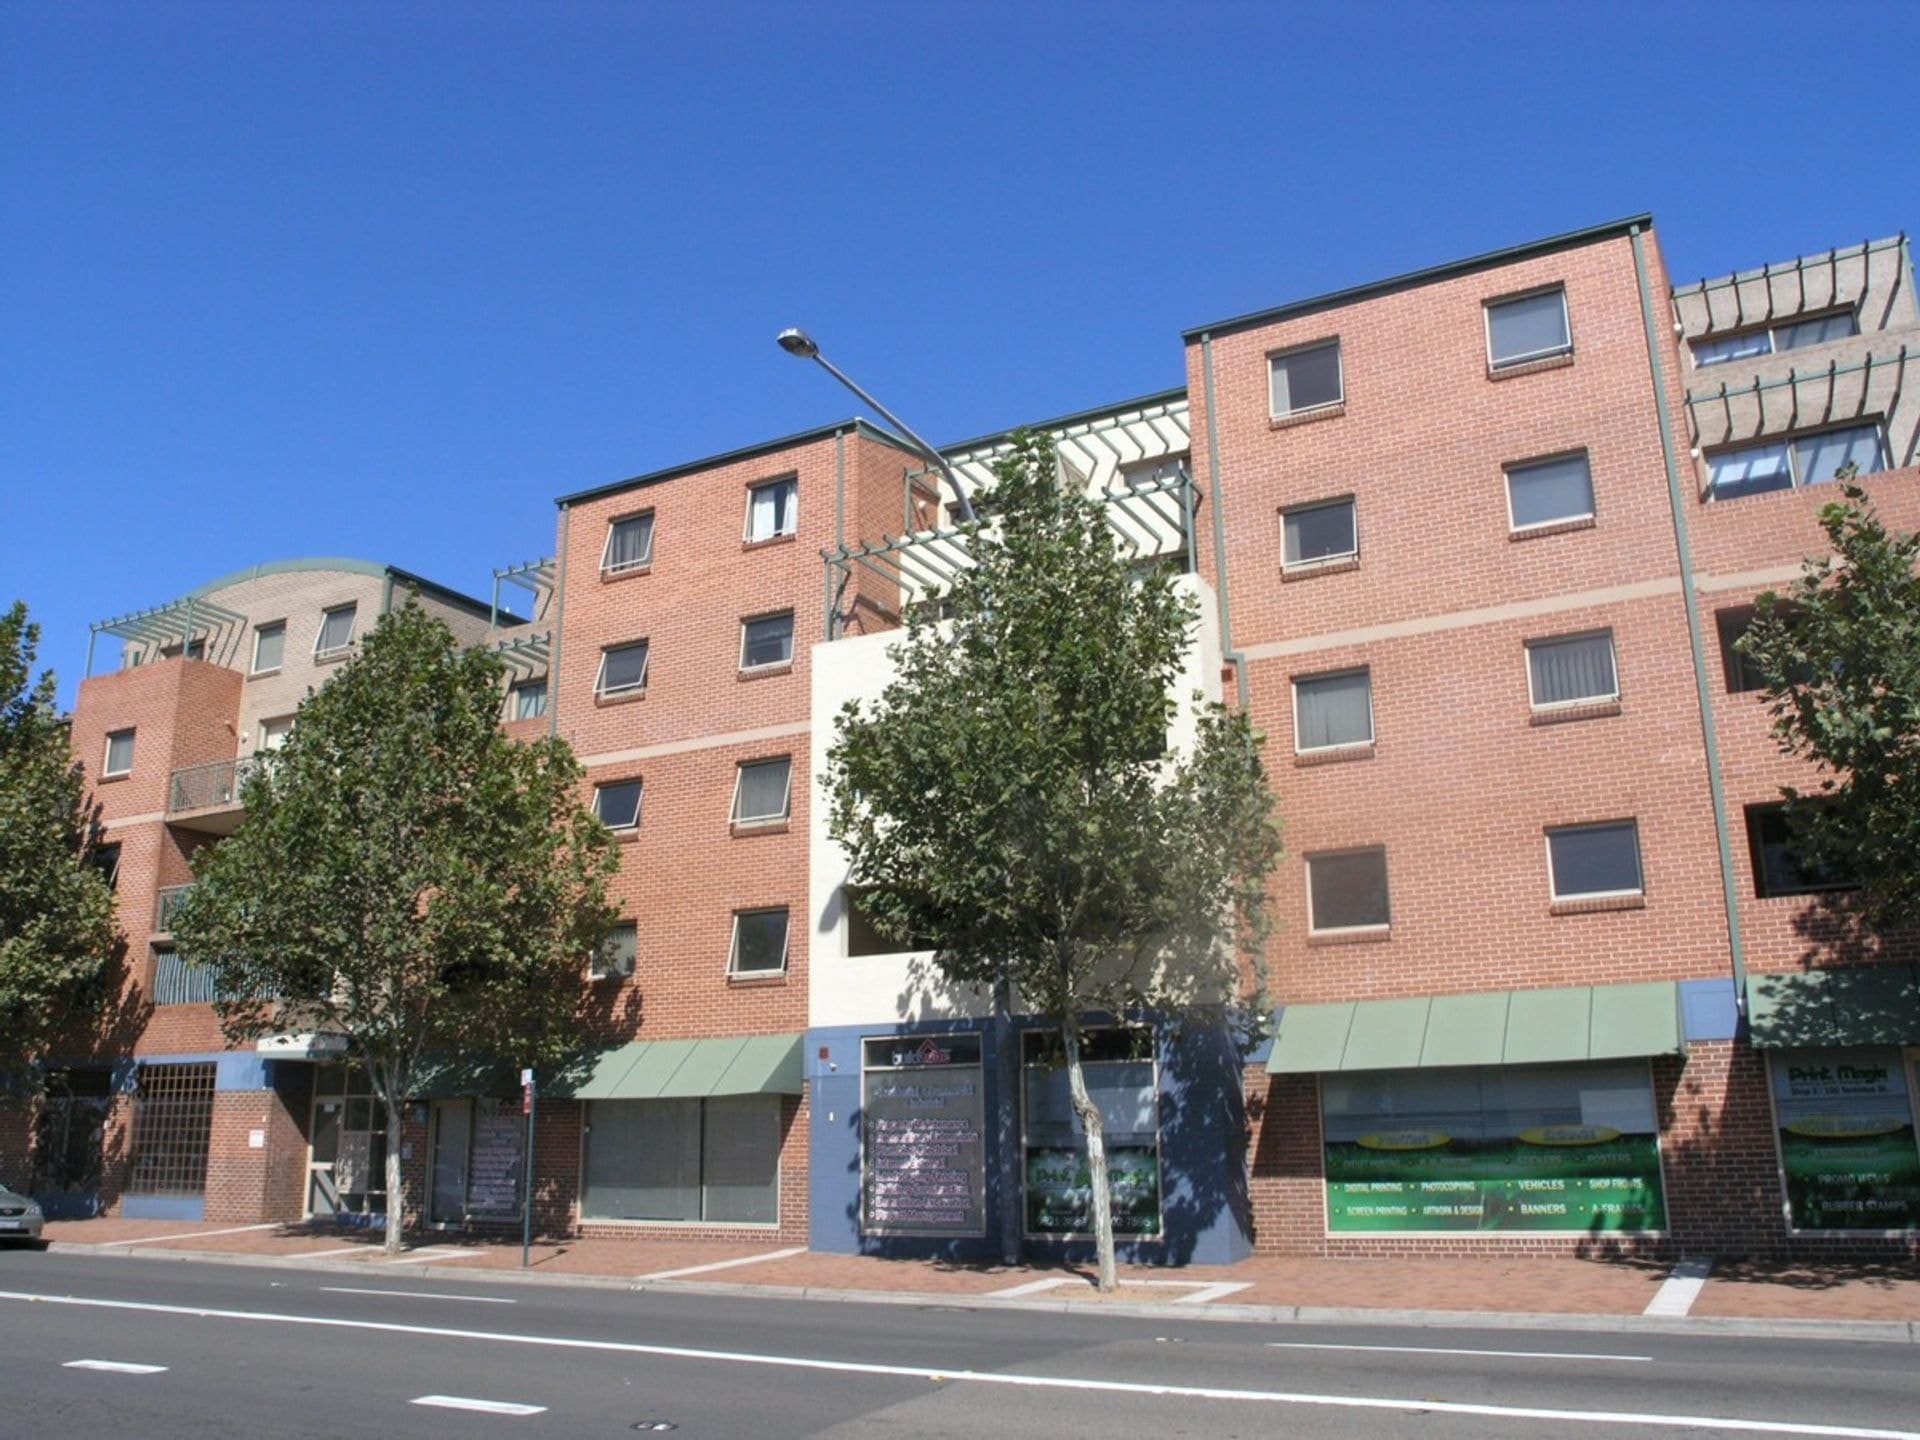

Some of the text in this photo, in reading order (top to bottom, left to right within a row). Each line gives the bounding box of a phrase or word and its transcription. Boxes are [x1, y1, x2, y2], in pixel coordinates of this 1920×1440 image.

[1789, 1064, 1888, 1083] Print Magic
[1371, 1182, 1403, 1193] PRINTING
[1518, 1179, 1565, 1191] VEHICLES
[1589, 1179, 1611, 1190] SHOP
[1347, 1206, 1408, 1216] SCREEN PRINTING
[1520, 1203, 1567, 1215] BANNERS
